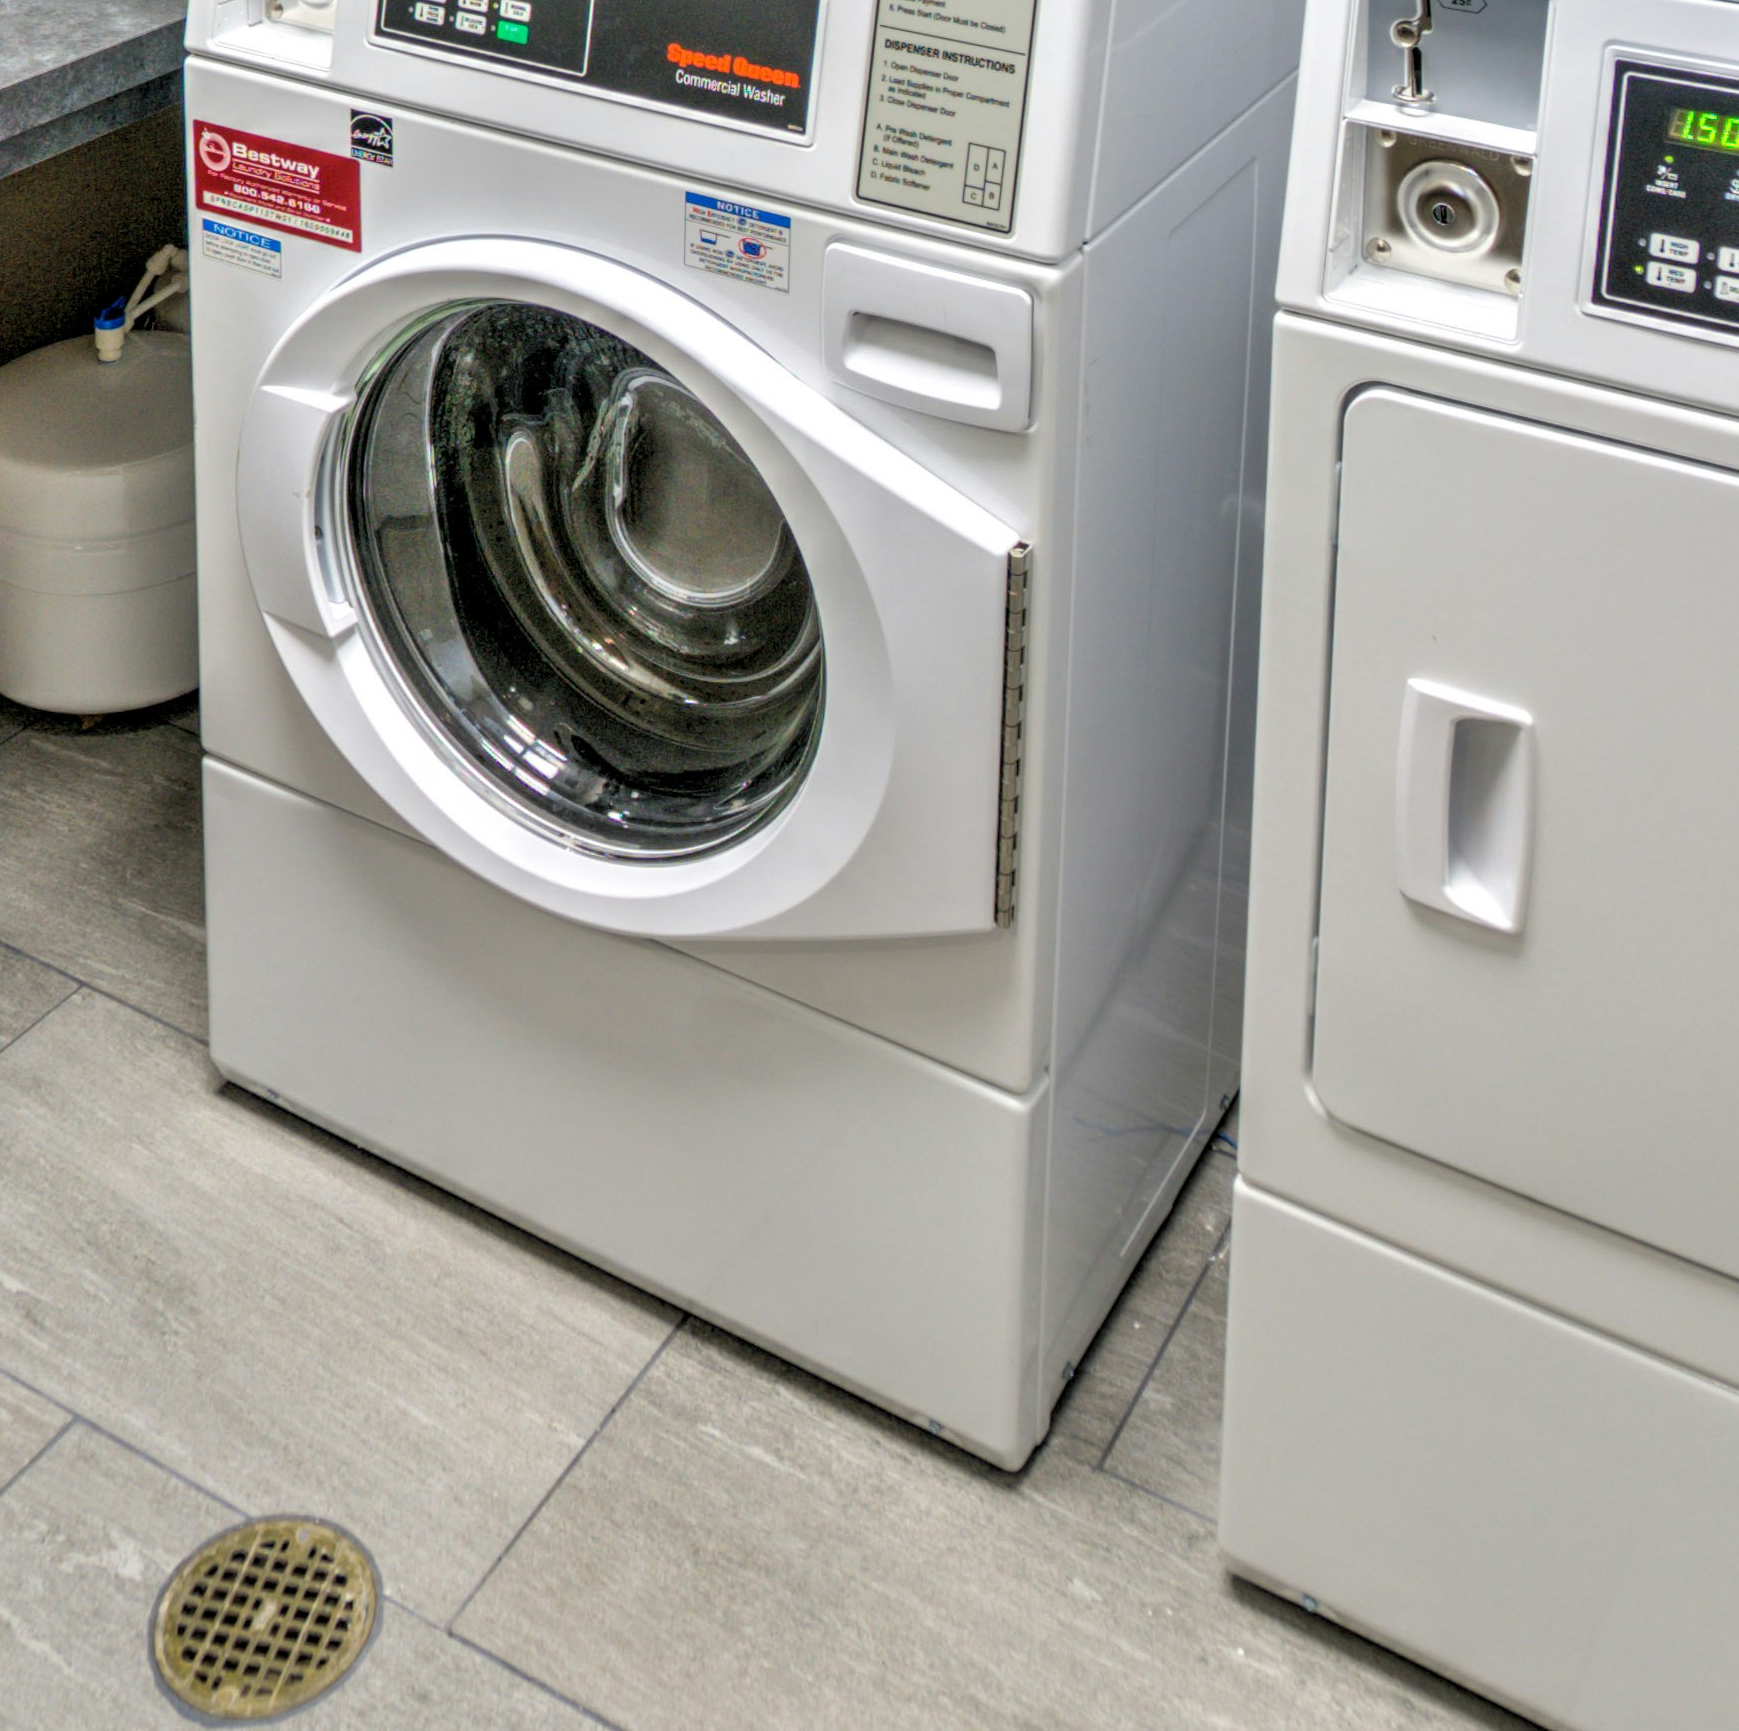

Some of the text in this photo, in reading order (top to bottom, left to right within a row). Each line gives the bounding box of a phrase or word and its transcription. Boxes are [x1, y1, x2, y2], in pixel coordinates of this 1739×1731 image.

[897, 6, 915, 16] Press
[917, 10, 932, 18] Start
[667, 43, 800, 88] Speed Queen
[885, 39, 1015, 74] DISPENSER INSTRUCTIONS
[891, 62, 908, 72] Open
[944, 72, 959, 82] Door
[676, 69, 785, 106] Commercial Washer
[940, 107, 956, 117] Door
[232, 142, 319, 179] Bestway
[232, 162, 320, 190] Laundry Solutions
[717, 201, 760, 219] NOTICE
[214, 224, 270, 248] NOTICE
